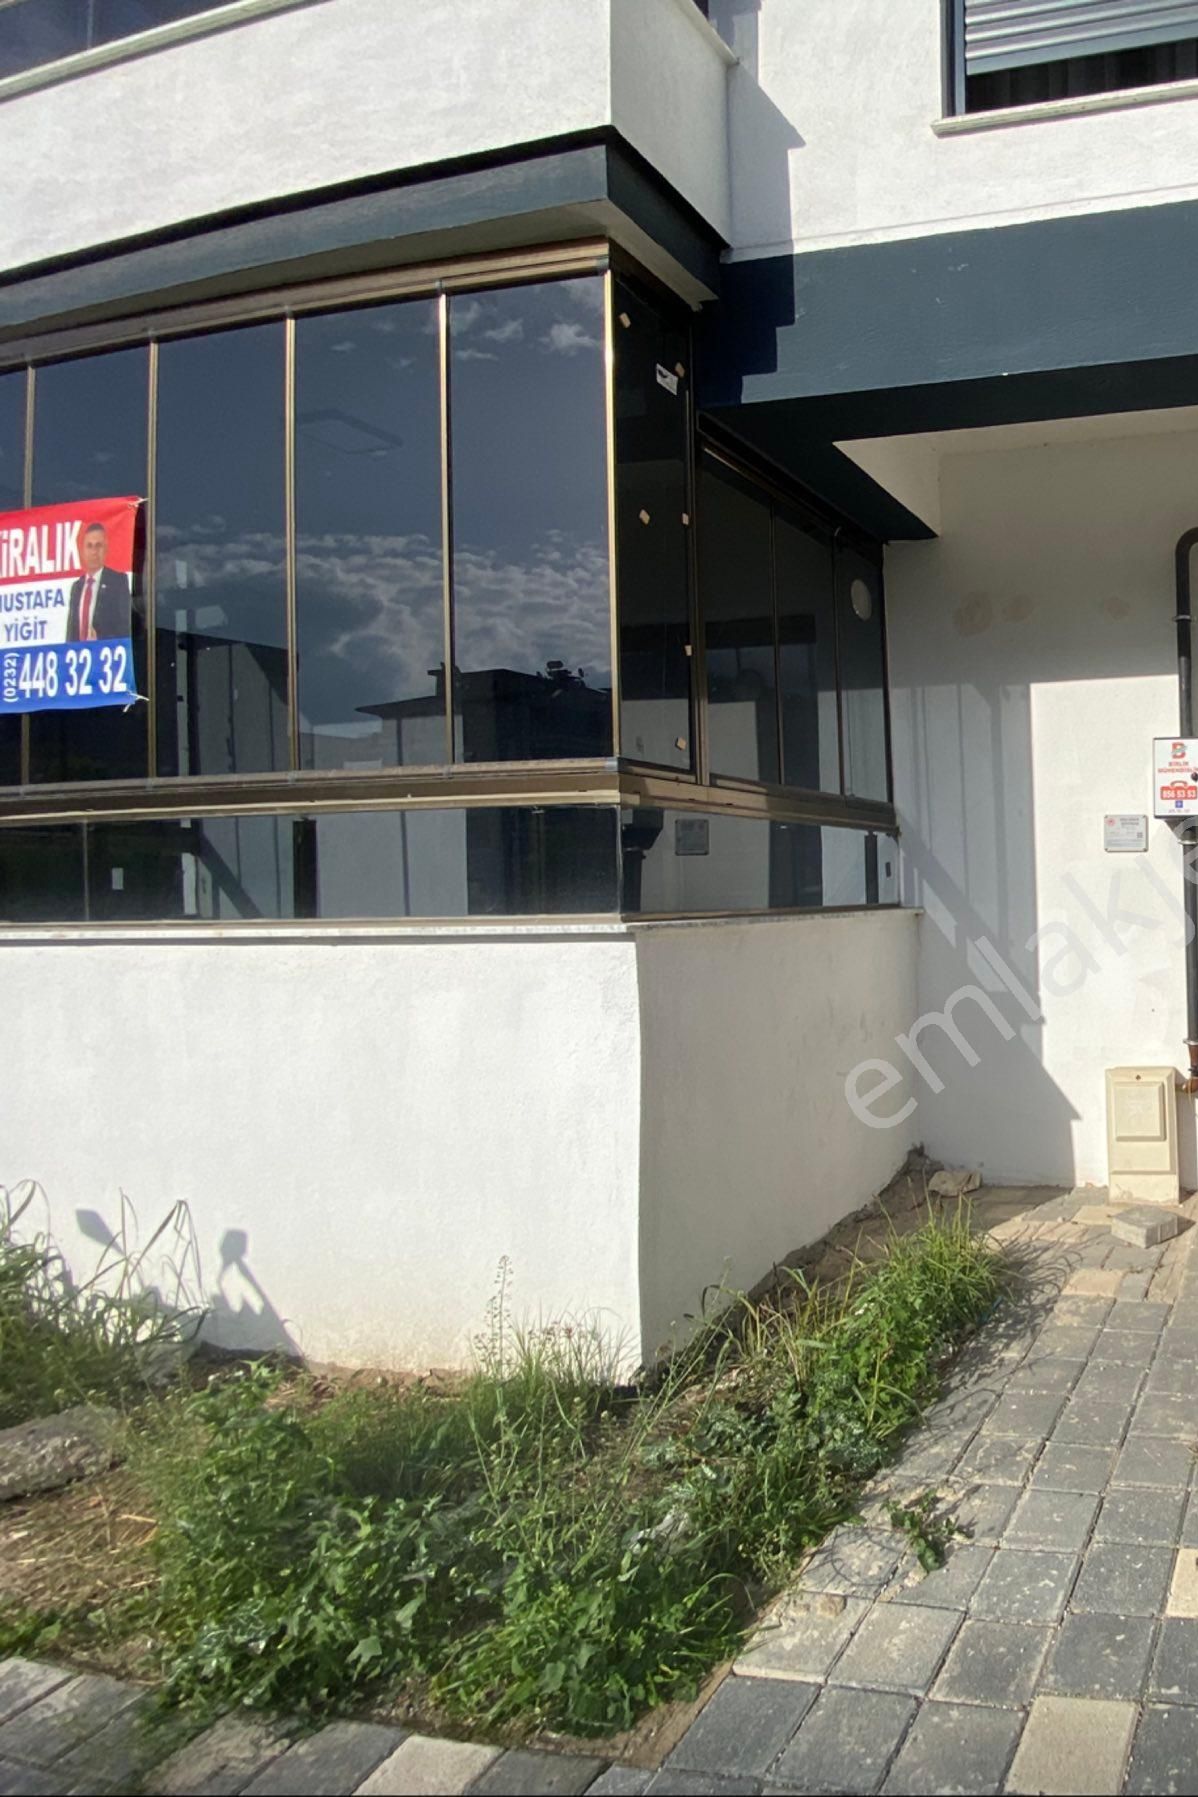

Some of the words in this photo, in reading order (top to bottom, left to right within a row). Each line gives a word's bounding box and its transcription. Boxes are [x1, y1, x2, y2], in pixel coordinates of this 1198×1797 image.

[0, 520, 82, 577] İRALIK
[0, 588, 65, 612] USTAFA
[4, 616, 47, 641] YİĞİT
[4, 652, 19, 702] (0232)
[19, 651, 58, 698] 448
[65, 649, 93, 695] 32
[98, 645, 127, 694] 32
